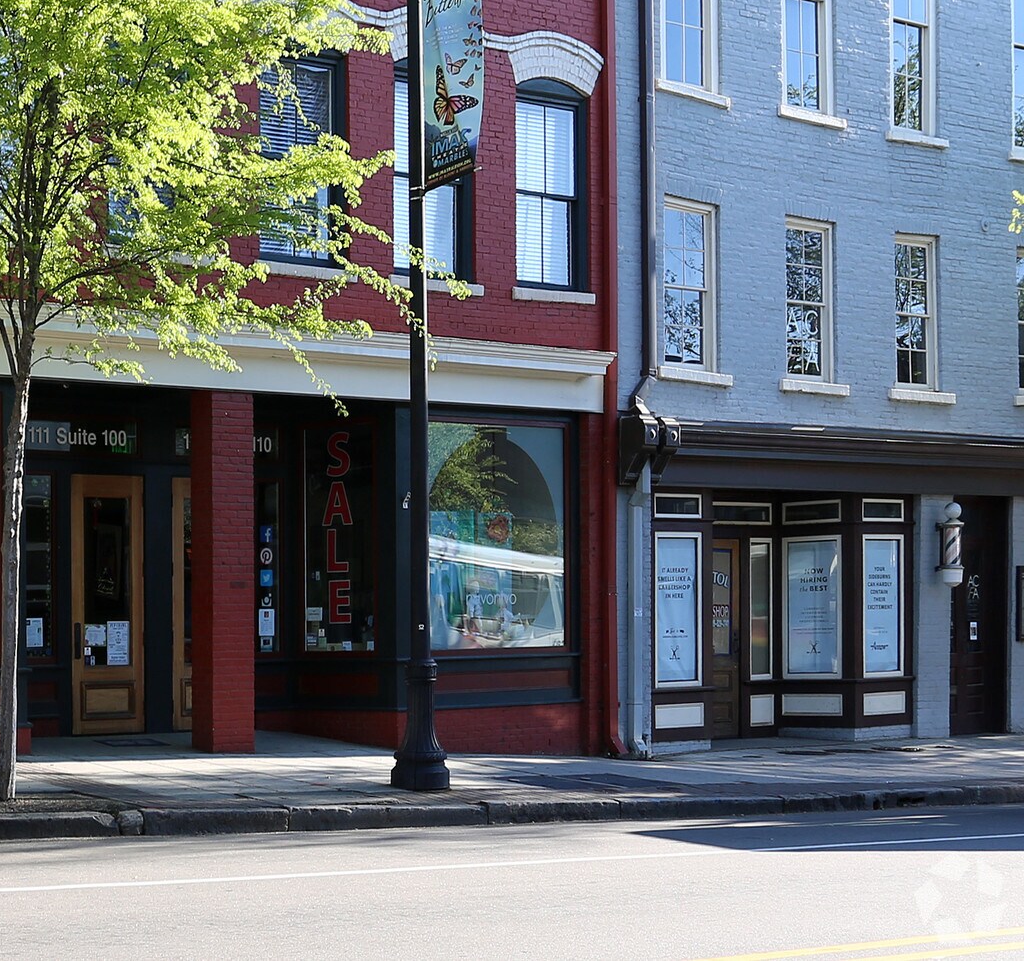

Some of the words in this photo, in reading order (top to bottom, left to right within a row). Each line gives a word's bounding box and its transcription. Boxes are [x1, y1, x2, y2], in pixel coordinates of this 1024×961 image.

[28, 427, 50, 444] 111
[56, 428, 97, 446] Suite
[101, 430, 127, 446] 100
[322, 431, 353, 624] SALE
[800, 576, 828, 584] HIRING
[968, 574, 980, 587] AC
[969, 588, 980, 599] FA
[713, 605, 728, 618] SHOP
